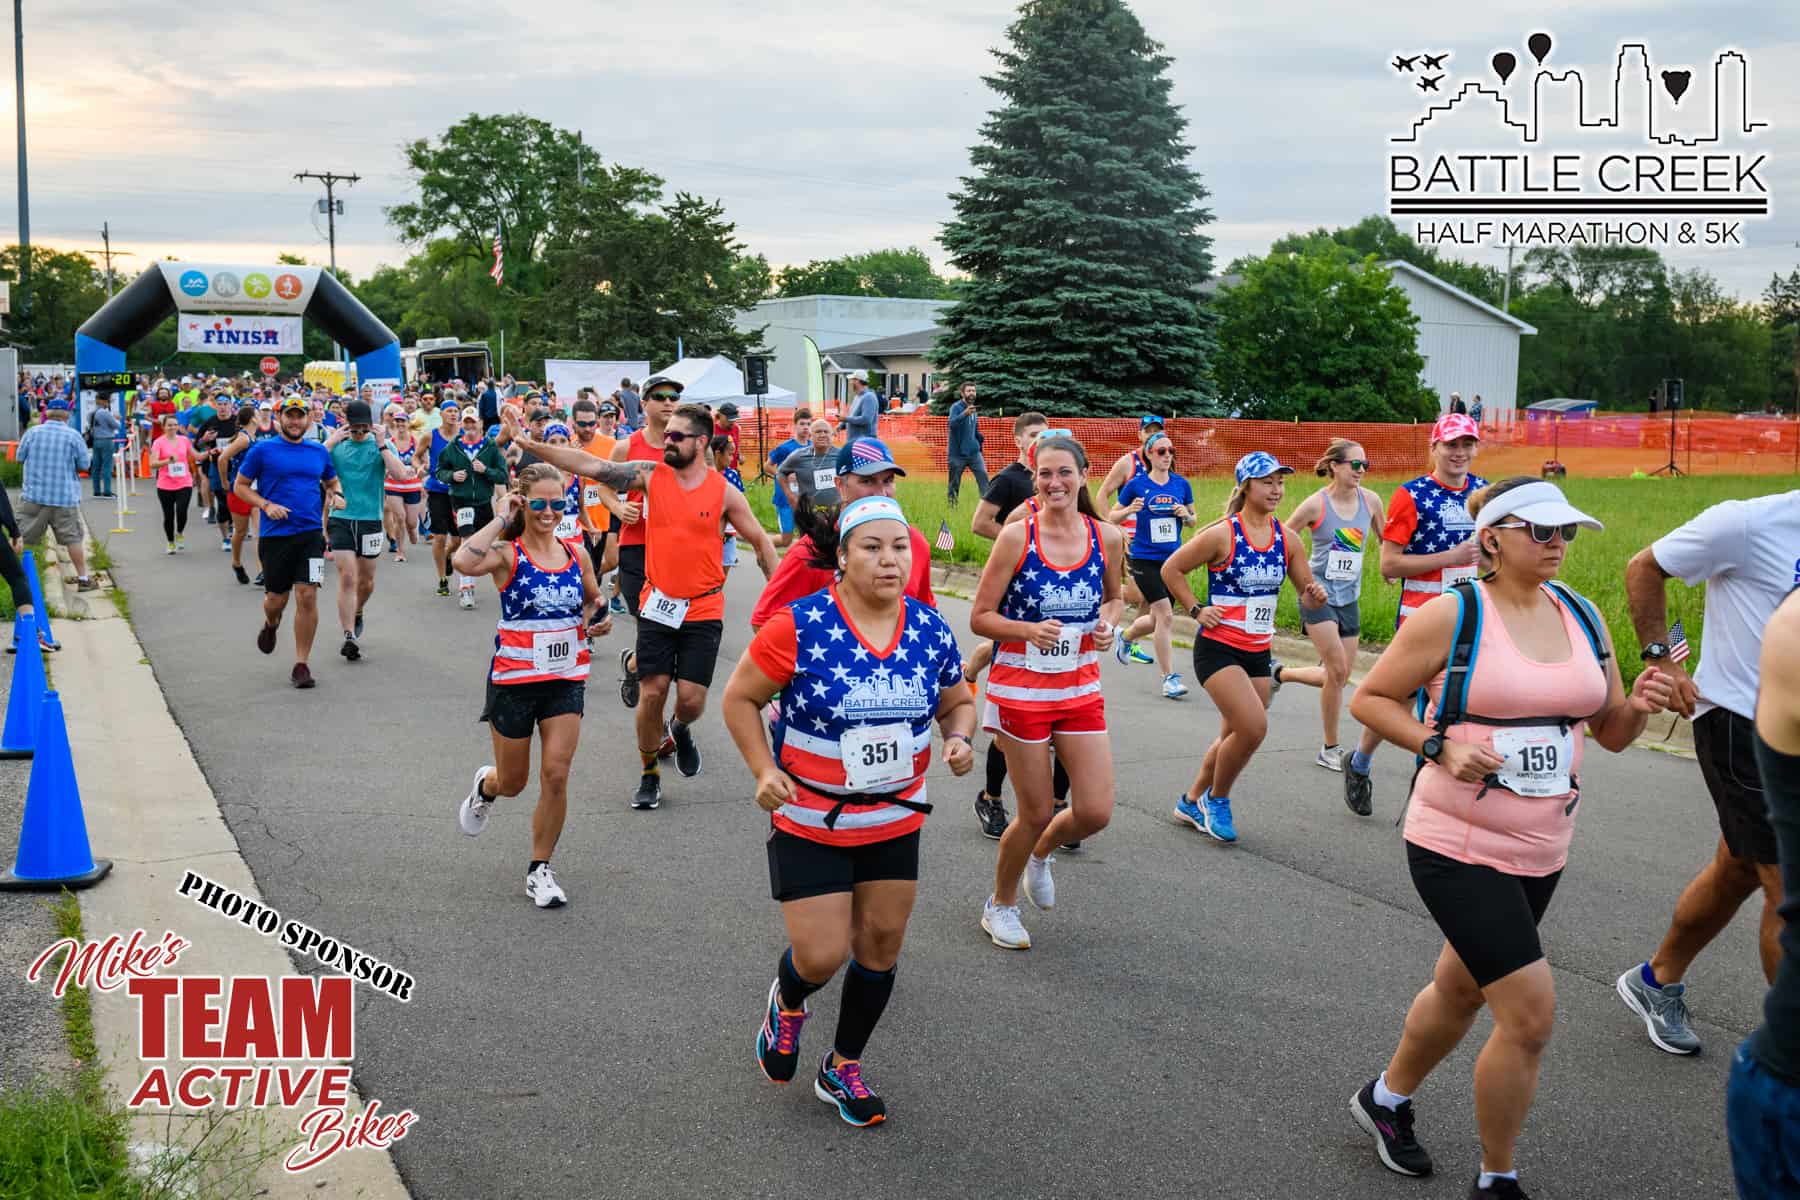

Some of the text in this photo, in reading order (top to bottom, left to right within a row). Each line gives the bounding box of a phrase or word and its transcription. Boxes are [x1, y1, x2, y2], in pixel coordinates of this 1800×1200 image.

[204, 329, 279, 345] FINISH
[261, 362, 279, 370] STOP
[1338, 559, 1353, 571] 112
[656, 598, 678, 616] 182
[546, 641, 569, 658] 100
[844, 696, 927, 708] BATTLE CREEK
[862, 740, 898, 766] 351
[1518, 744, 1558, 772] 159
